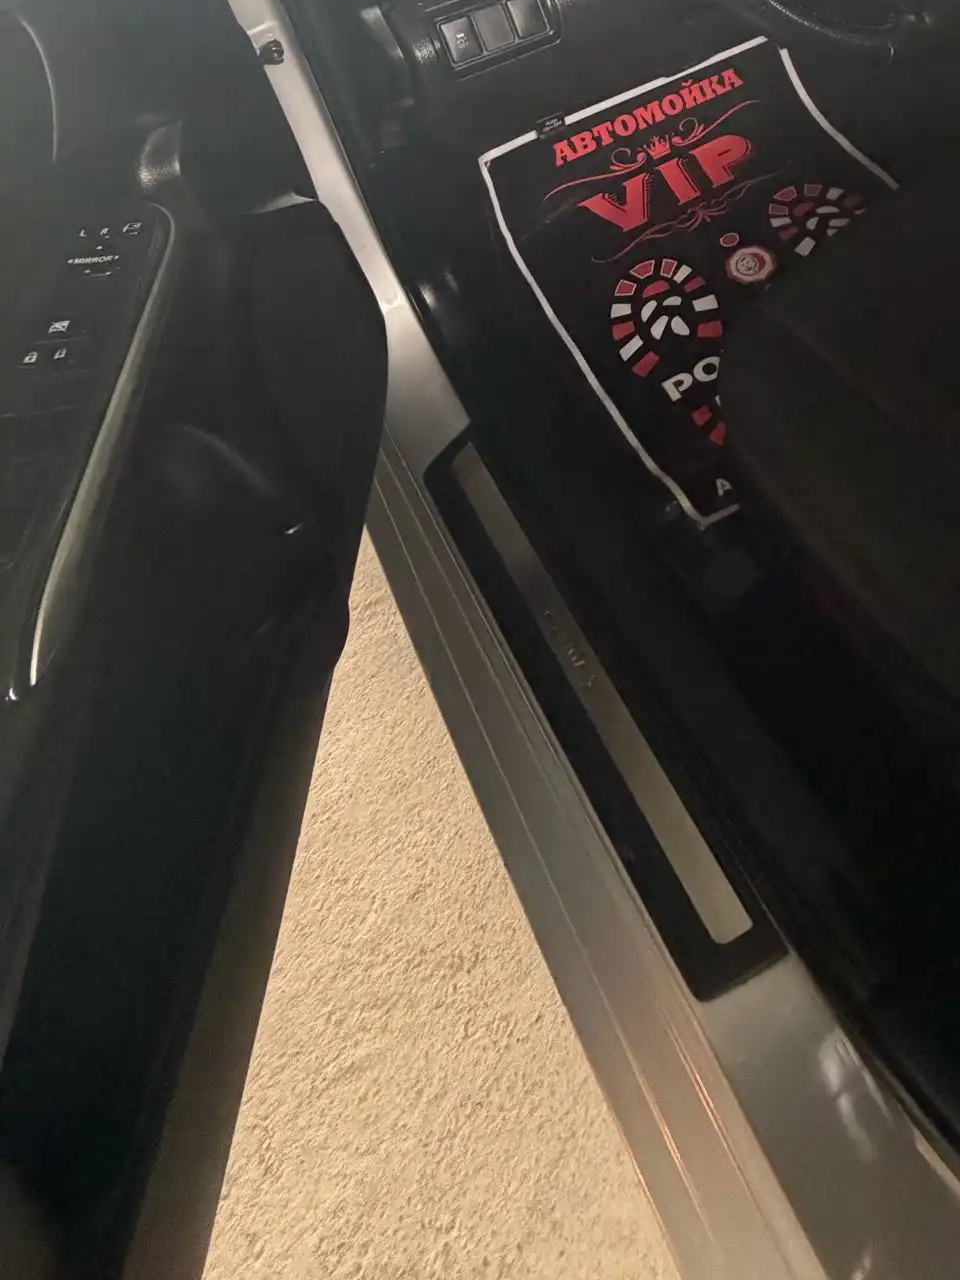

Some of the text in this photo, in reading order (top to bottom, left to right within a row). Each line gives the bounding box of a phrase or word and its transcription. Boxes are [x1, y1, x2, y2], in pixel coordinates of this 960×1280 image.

[553, 68, 744, 167] АВТОМОЙКА
[577, 134, 751, 232] VIP
[72, 255, 114, 265] MIRROR
